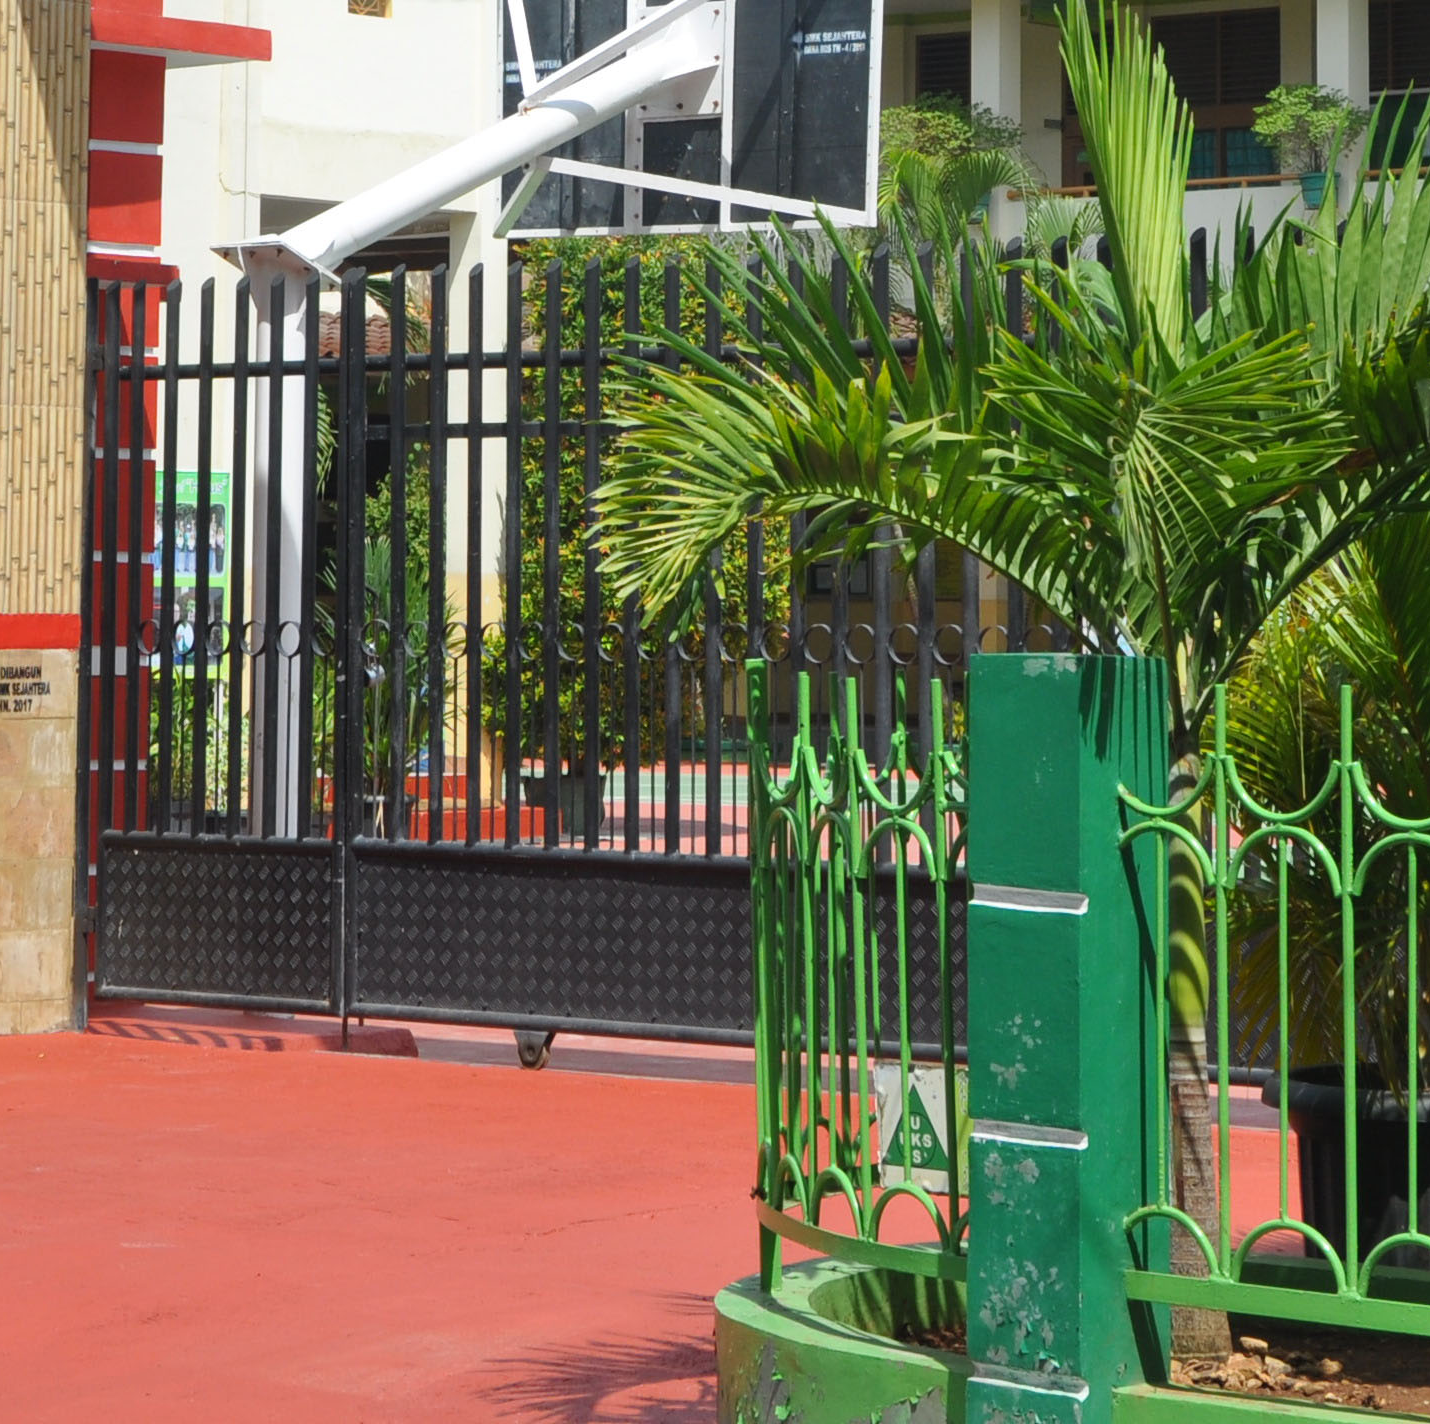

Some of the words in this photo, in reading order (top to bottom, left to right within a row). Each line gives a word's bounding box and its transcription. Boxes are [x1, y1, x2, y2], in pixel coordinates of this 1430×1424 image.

[0, 665, 42, 679] DIBANGUN
[12, 681, 51, 696] SEJAHTERA
[13, 698, 33, 712] 2017
